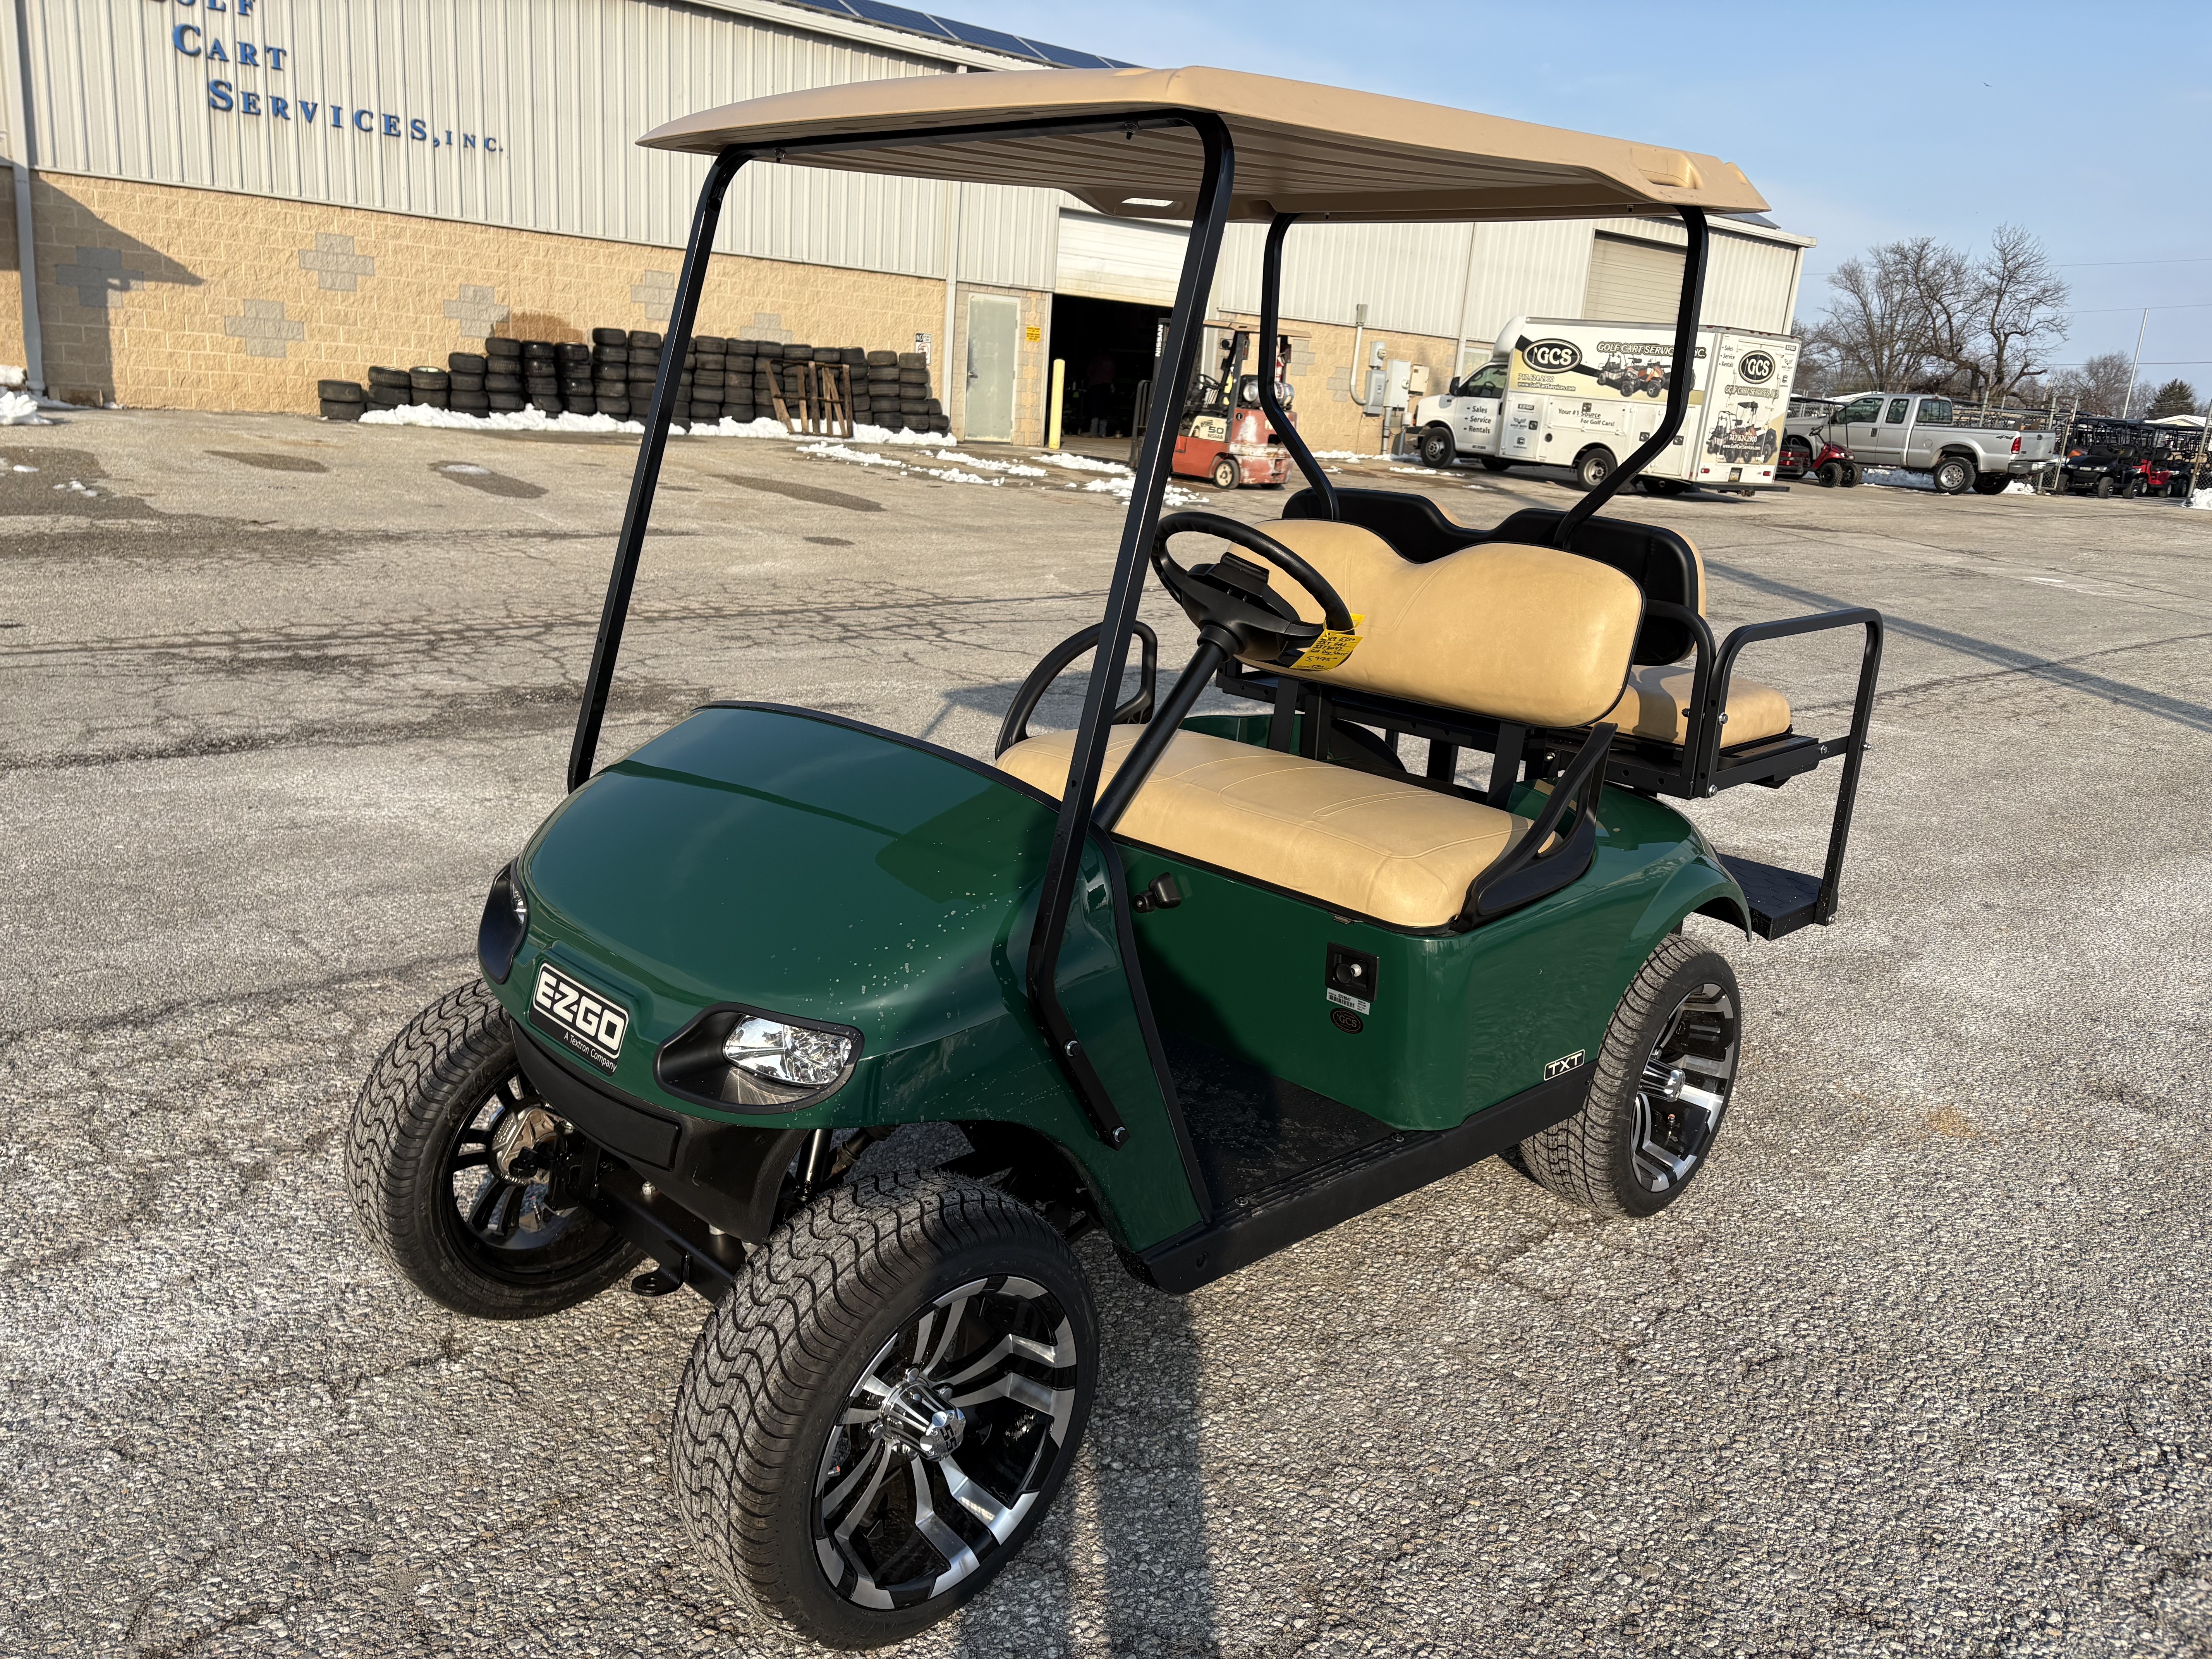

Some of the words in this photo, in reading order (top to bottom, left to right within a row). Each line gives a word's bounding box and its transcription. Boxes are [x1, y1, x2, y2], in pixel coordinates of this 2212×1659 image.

[172, 23, 287, 70] CART
[1155, 325, 1163, 357] NISSAN
[1597, 343, 1620, 352] GOLF
[1621, 344, 1644, 353] CART
[1644, 346, 1674, 356] SERVIC
[1537, 347, 1573, 366] GCS
[1748, 358, 1770, 376] GCS
[1208, 426, 1224, 434] 50
[1469, 425, 1490, 434] Rentals
[1339, 1015, 1357, 1027] GCS
[564, 1032, 568, 1041] A
[570, 1034, 589, 1054] Textron
[590, 1049, 617, 1073] Company
[1548, 1052, 1582, 1075] TXT
